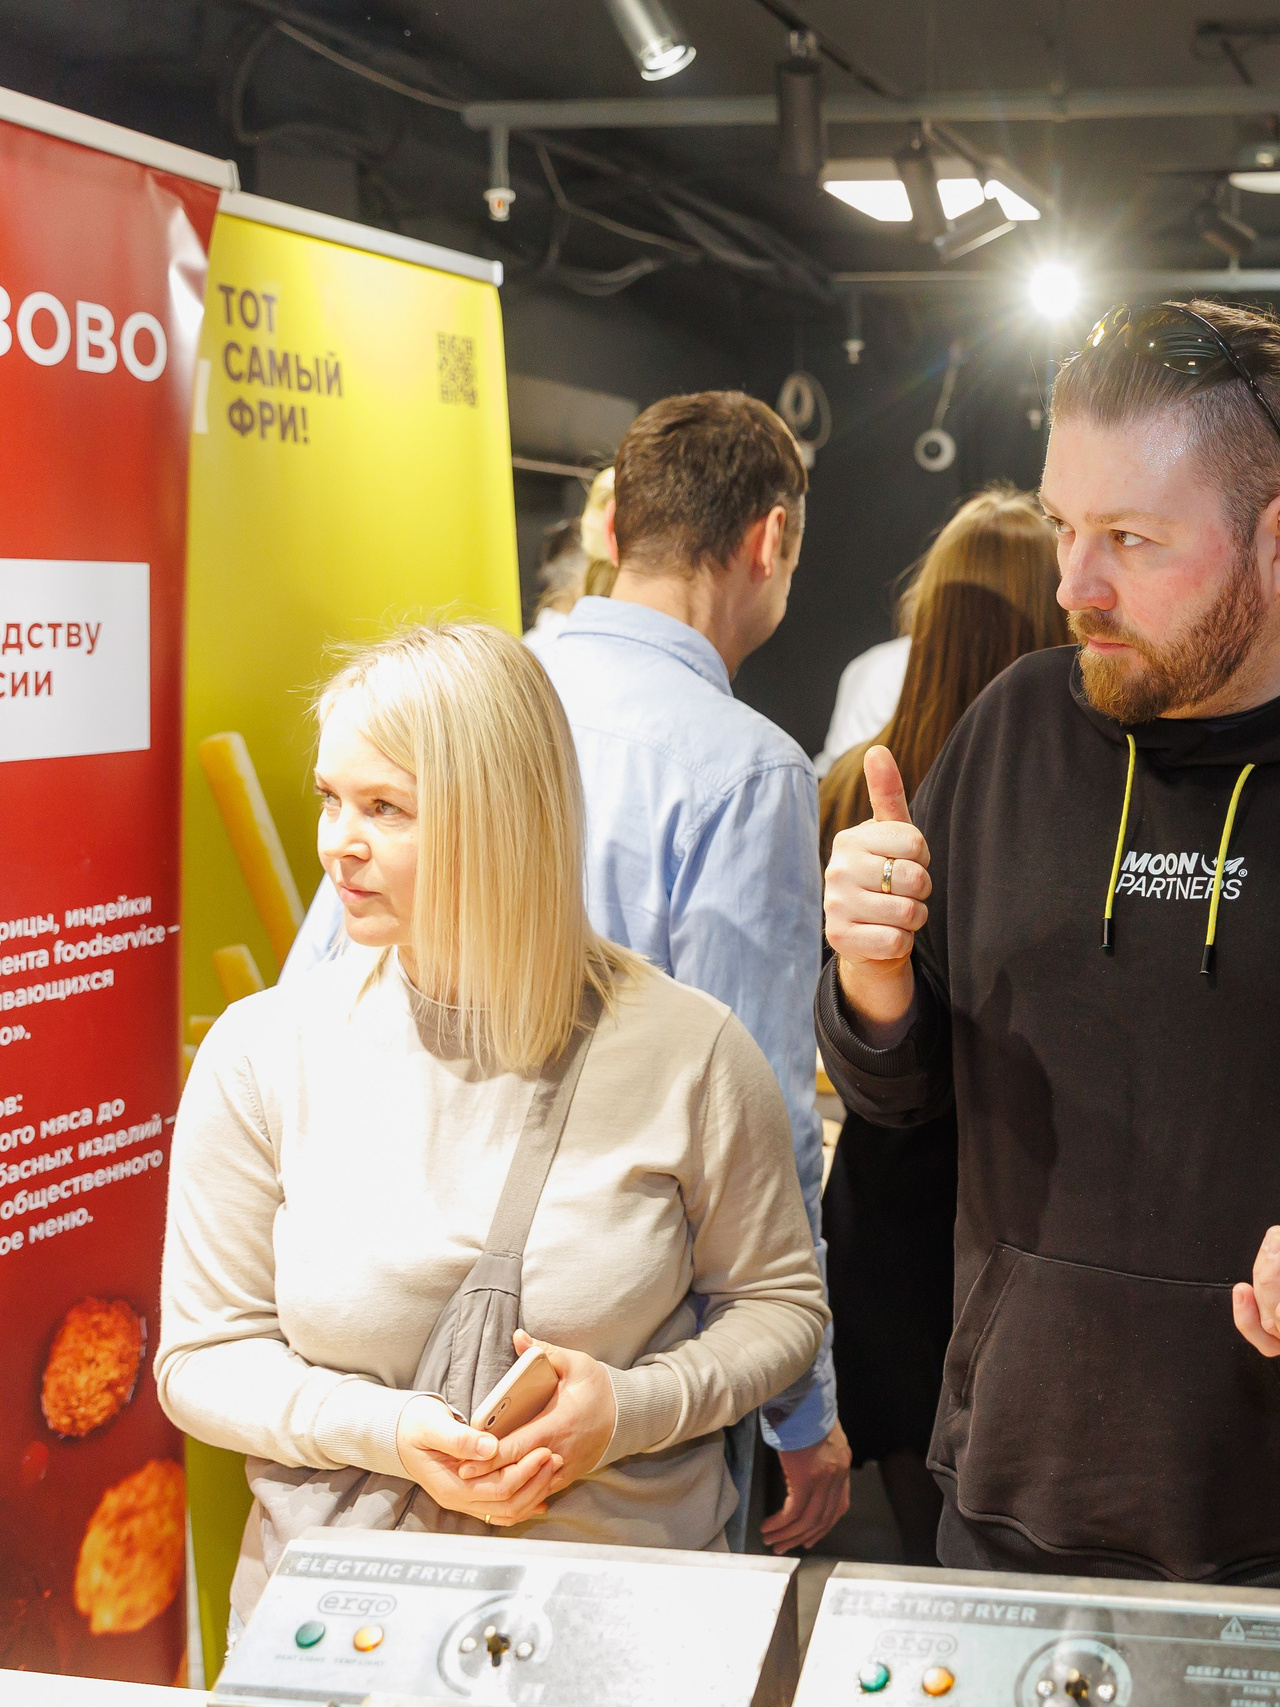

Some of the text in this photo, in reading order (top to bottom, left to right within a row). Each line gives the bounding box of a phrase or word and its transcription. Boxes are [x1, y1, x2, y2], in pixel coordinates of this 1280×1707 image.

[218, 283, 277, 332] ТОТ
[0, 285, 167, 382] ОВО
[223, 341, 343, 397] САМЫЙ
[227, 397, 310, 444] ФРИ!
[1120, 851, 1199, 875] MOON
[65, 894, 152, 928] индейки
[0, 949, 49, 976] ента
[53, 924, 166, 964] foodservice
[0, 968, 115, 1012] вающихся
[40, 1107, 93, 1139] мяса
[96, 1098, 126, 1125] до
[78, 1112, 162, 1161] изделий
[1, 1149, 163, 1220] общественного
[28, 1207, 94, 1244] меню.
[297, 1557, 479, 1584] ELECTRIC FRYER
[323, 1595, 392, 1616] ergo
[840, 1597, 1038, 1622] ELECTRIC FRYER
